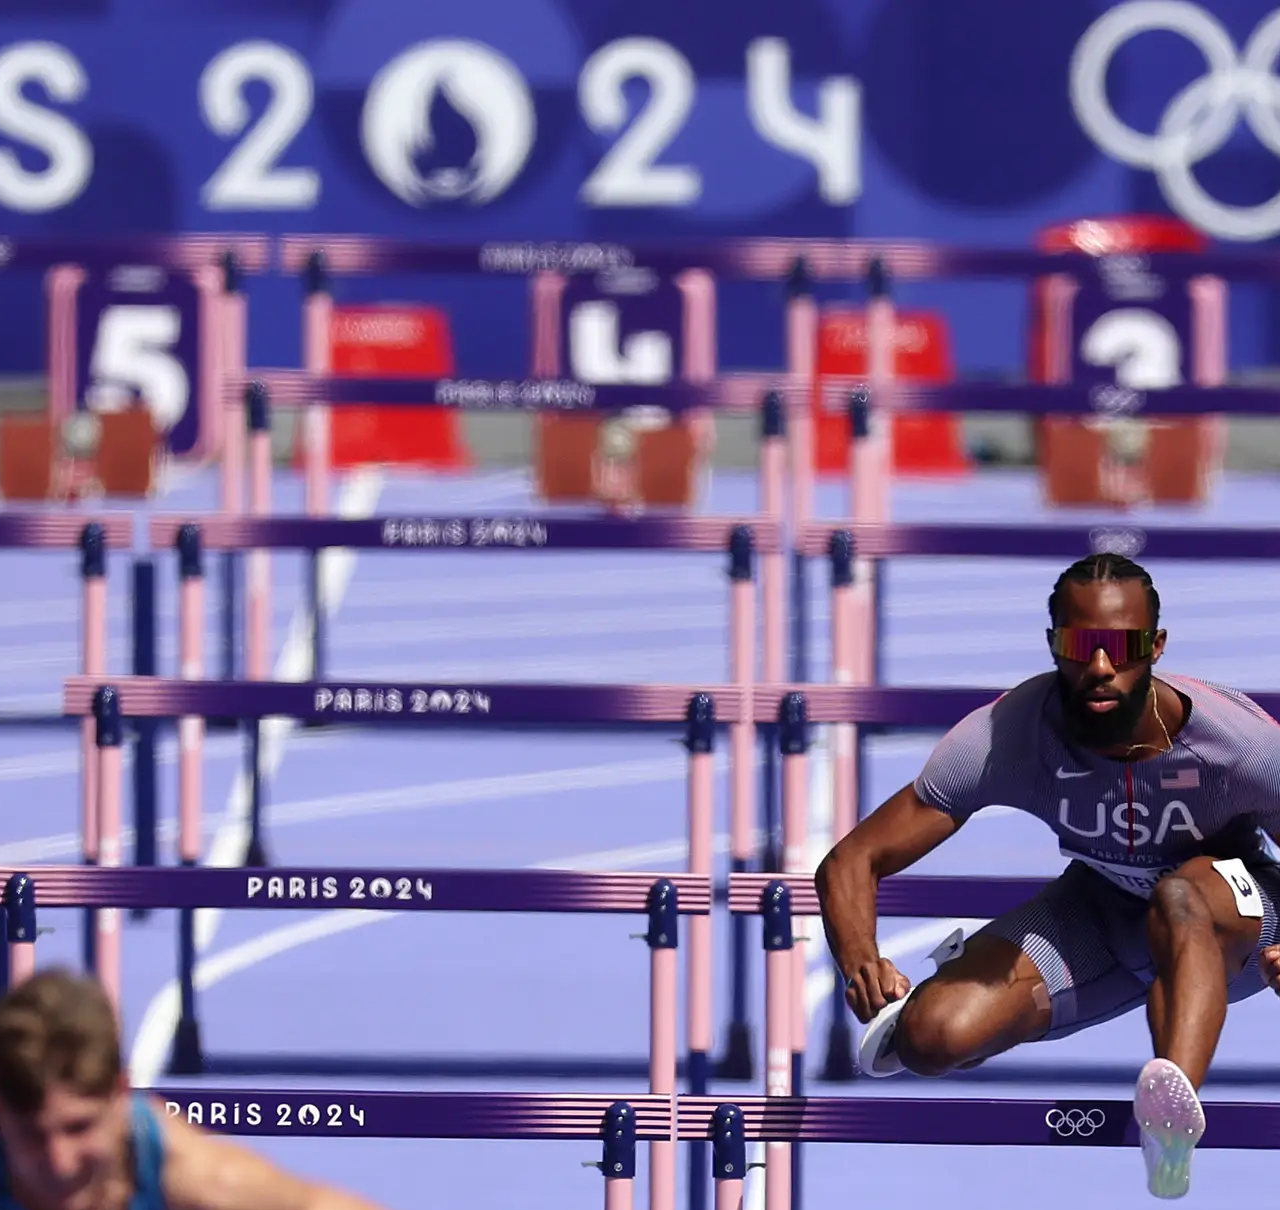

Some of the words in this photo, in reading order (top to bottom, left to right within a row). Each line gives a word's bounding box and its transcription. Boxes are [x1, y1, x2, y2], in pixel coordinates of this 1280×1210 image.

[199, 37, 863, 210] 2024
[85, 304, 190, 436] 5
[1059, 798, 1204, 846] USA
[247, 876, 338, 899] PARIS
[349, 877, 432, 900] 2024
[1231, 875, 1252, 897] 3
[276, 1103, 365, 1126] 2024
